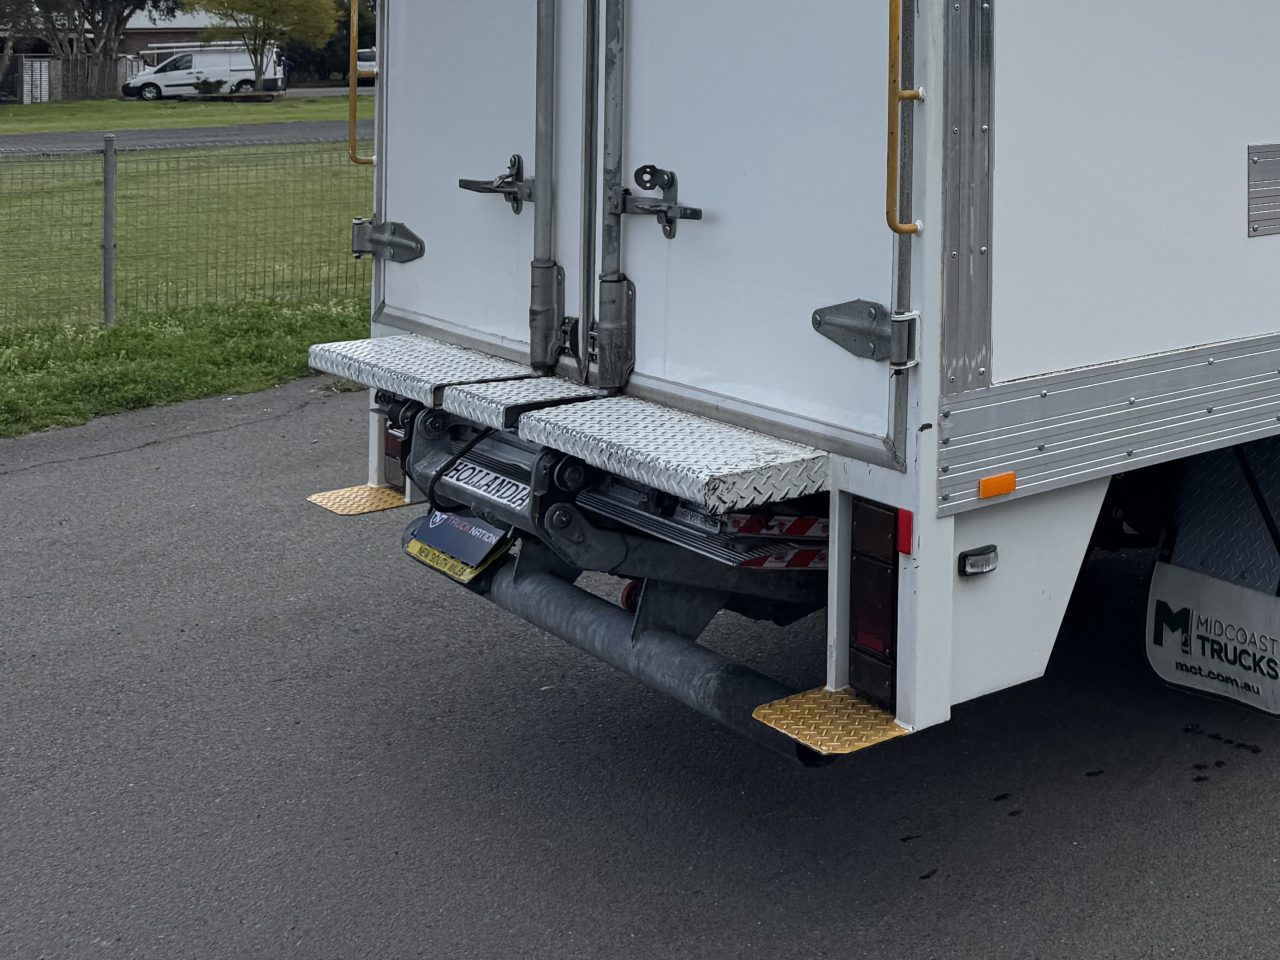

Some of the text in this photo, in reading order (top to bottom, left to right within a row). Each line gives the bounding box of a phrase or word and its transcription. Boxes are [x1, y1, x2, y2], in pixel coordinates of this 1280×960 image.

[1196, 615, 1279, 655] MIDCOAST
[1196, 634, 1280, 680] TRUCKS
[1175, 660, 1261, 696] mct.com.au
